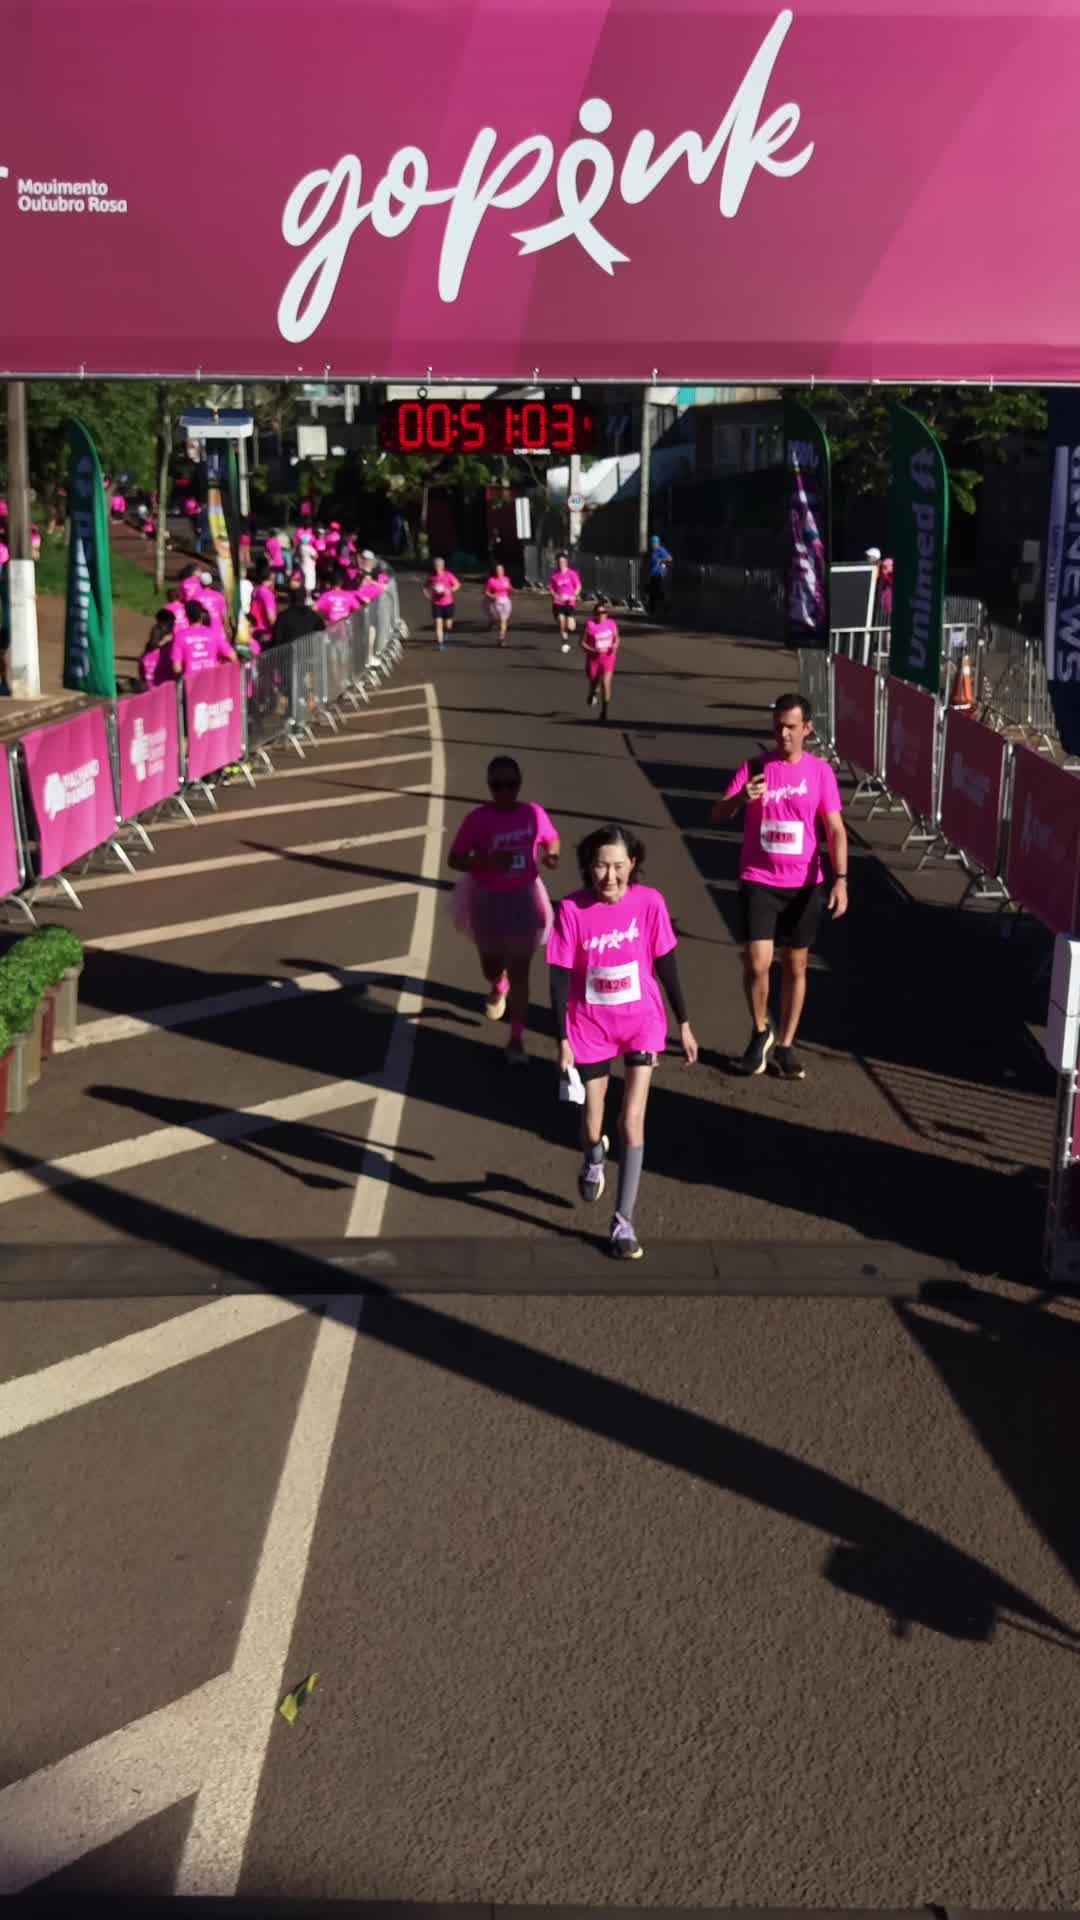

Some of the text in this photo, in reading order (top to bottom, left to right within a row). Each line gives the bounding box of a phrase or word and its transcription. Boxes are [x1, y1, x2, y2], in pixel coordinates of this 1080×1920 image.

[17, 195, 128, 213] Outubro Rosa
[908, 501, 936, 669] Unimed
